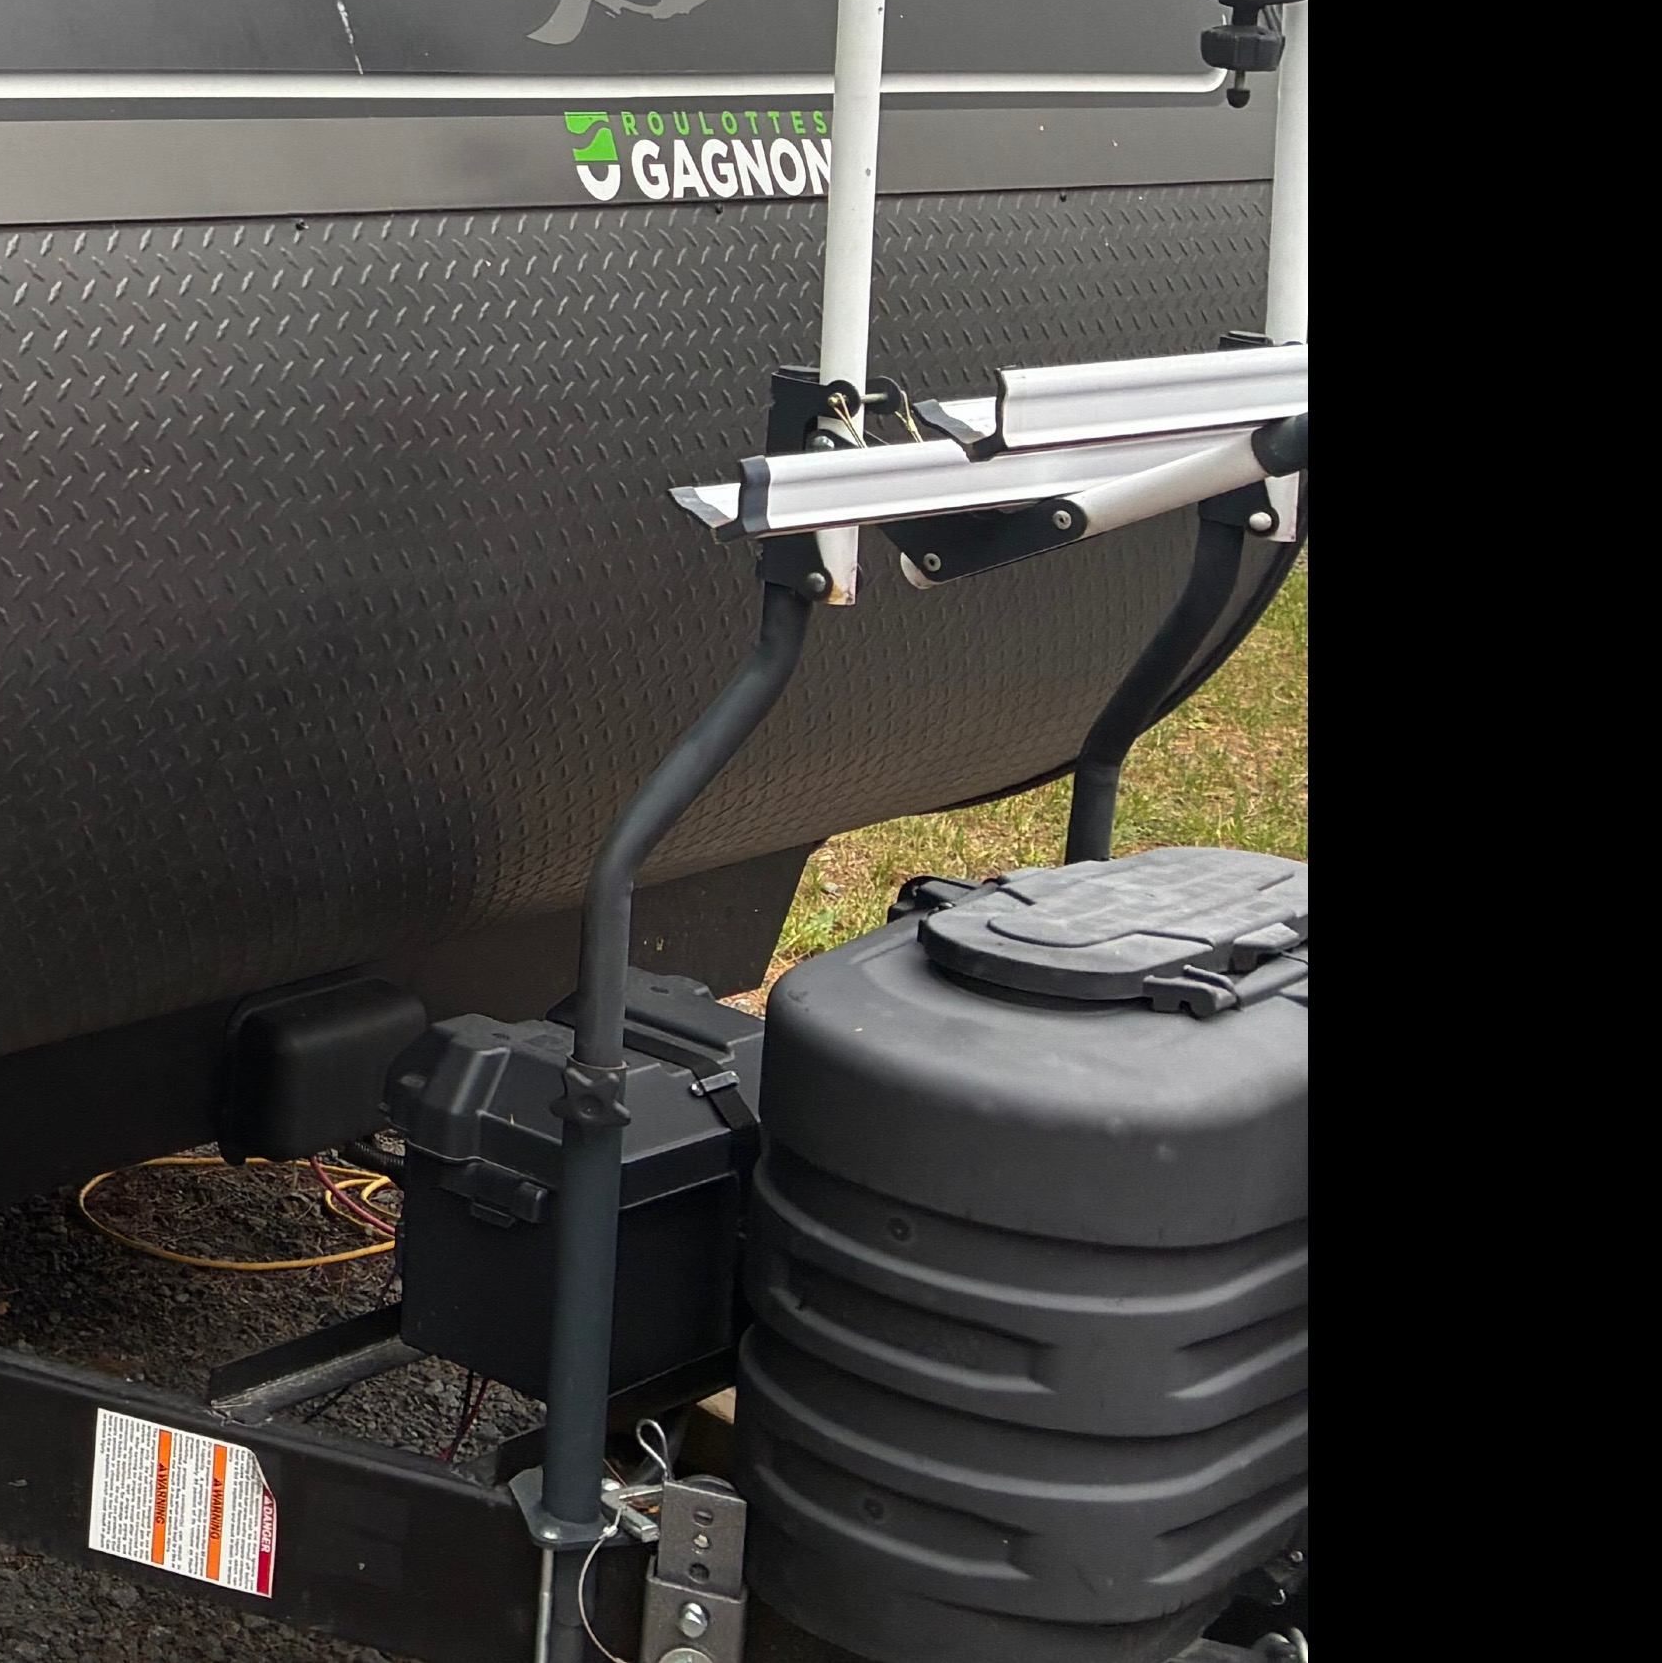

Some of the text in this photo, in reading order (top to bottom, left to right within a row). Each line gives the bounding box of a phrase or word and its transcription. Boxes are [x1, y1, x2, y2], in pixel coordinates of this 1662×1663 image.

[621, 110, 828, 137] ROULOTTES
[630, 137, 833, 201] GAGNON
[155, 1471, 169, 1525] WARNING
[209, 1487, 224, 1540] WARNING
[260, 1502, 273, 1554] DANGER
